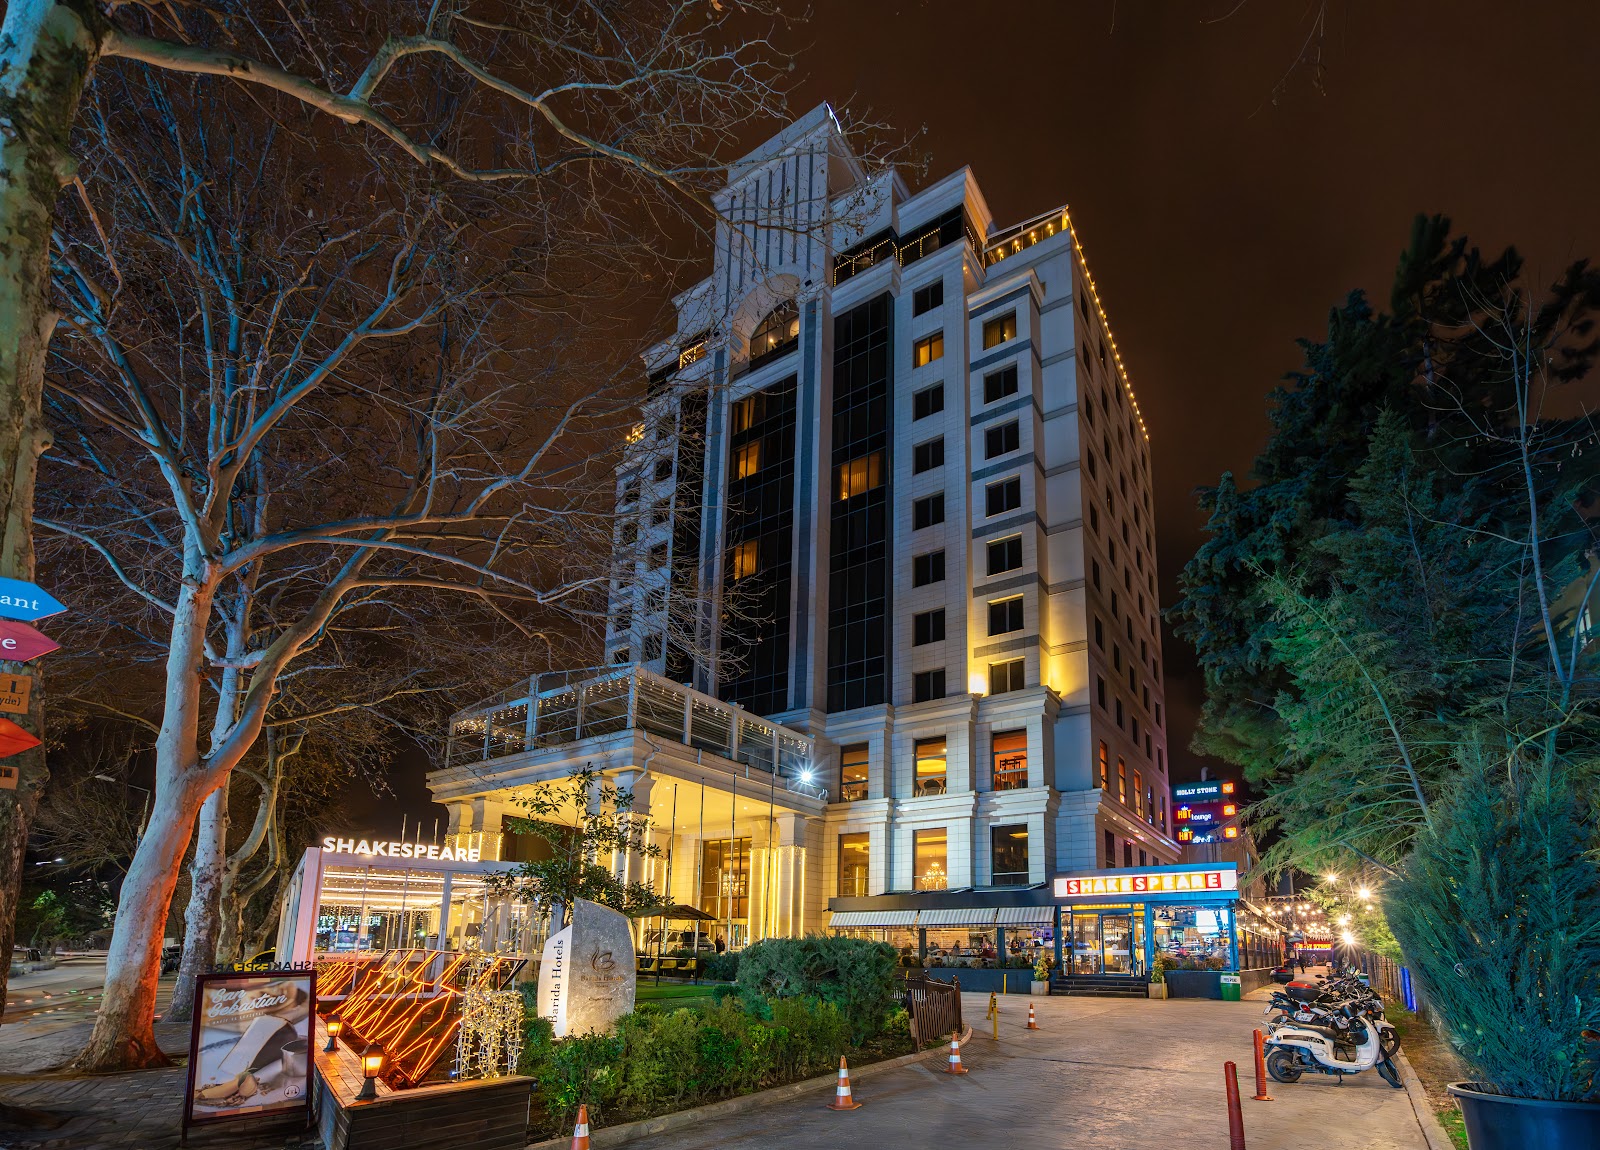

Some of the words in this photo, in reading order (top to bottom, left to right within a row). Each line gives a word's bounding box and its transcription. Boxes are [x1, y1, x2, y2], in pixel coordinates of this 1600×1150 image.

[1176, 788, 1196, 796] HOLLY
[1177, 809, 1192, 820] HOT
[1178, 830, 1194, 841] HOT
[322, 836, 480, 862] SHAKESPEARE
[1068, 873, 1220, 894] SHAKESPEARE
[552, 940, 563, 979] Hotels
[207, 993, 288, 1018] Sebastian
[212, 987, 247, 1003] San
[549, 983, 561, 1023] Barida
